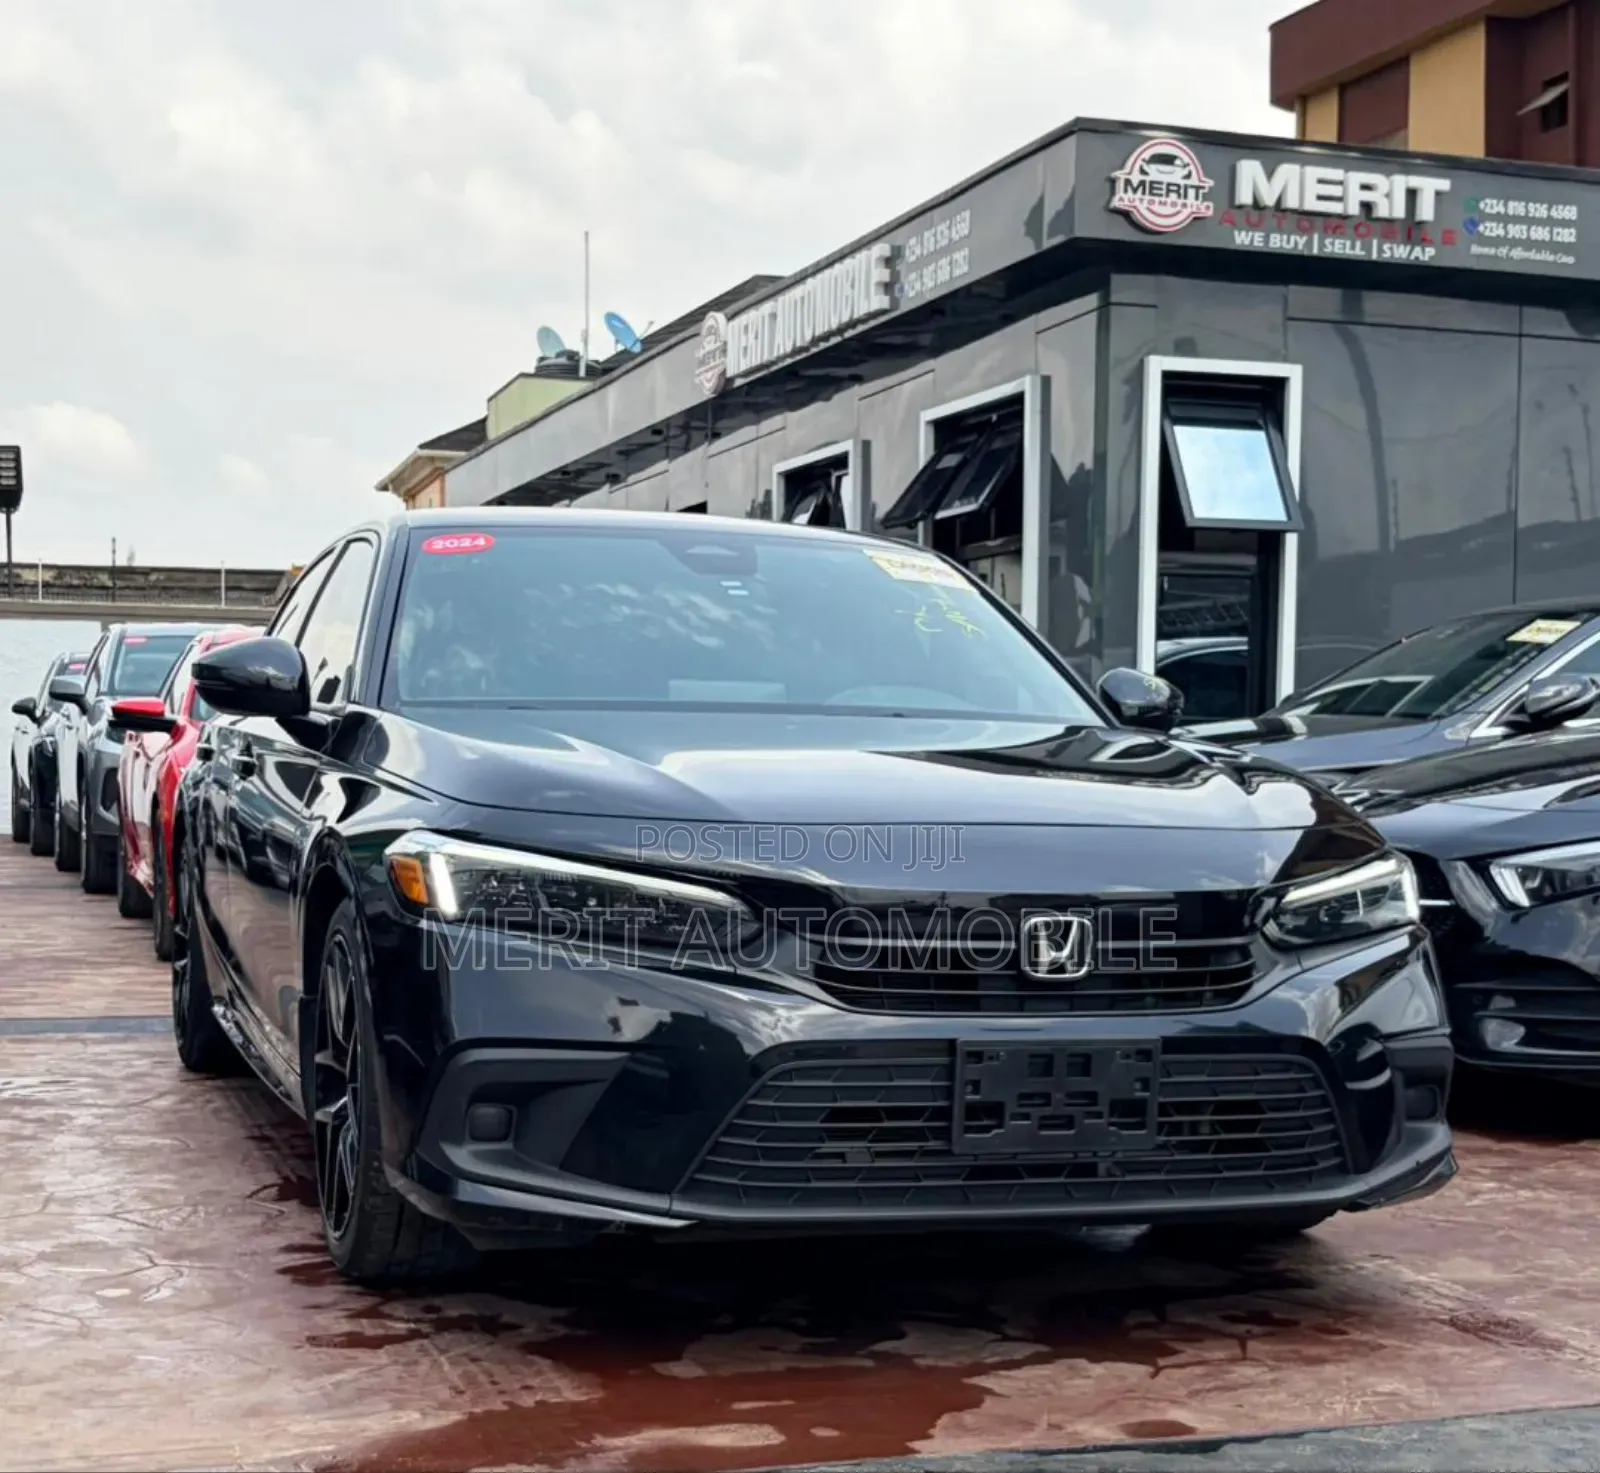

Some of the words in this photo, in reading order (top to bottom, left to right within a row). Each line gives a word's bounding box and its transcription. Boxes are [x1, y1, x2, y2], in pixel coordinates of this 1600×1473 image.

[1117, 194, 1212, 212] AUTOMOBILE
[1122, 177, 1207, 202] MERIT
[1234, 159, 1451, 222] MERIT
[1219, 211, 1457, 246] AUTOMOBILE
[1233, 229, 1265, 247] WE
[1268, 232, 1308, 251] BUY
[1323, 237, 1366, 257] SELL
[1381, 242, 1436, 262] SWAP
[727, 301, 777, 378] MERIT
[774, 243, 891, 354] AUTOMOBILE
[431, 536, 486, 549] 2024
